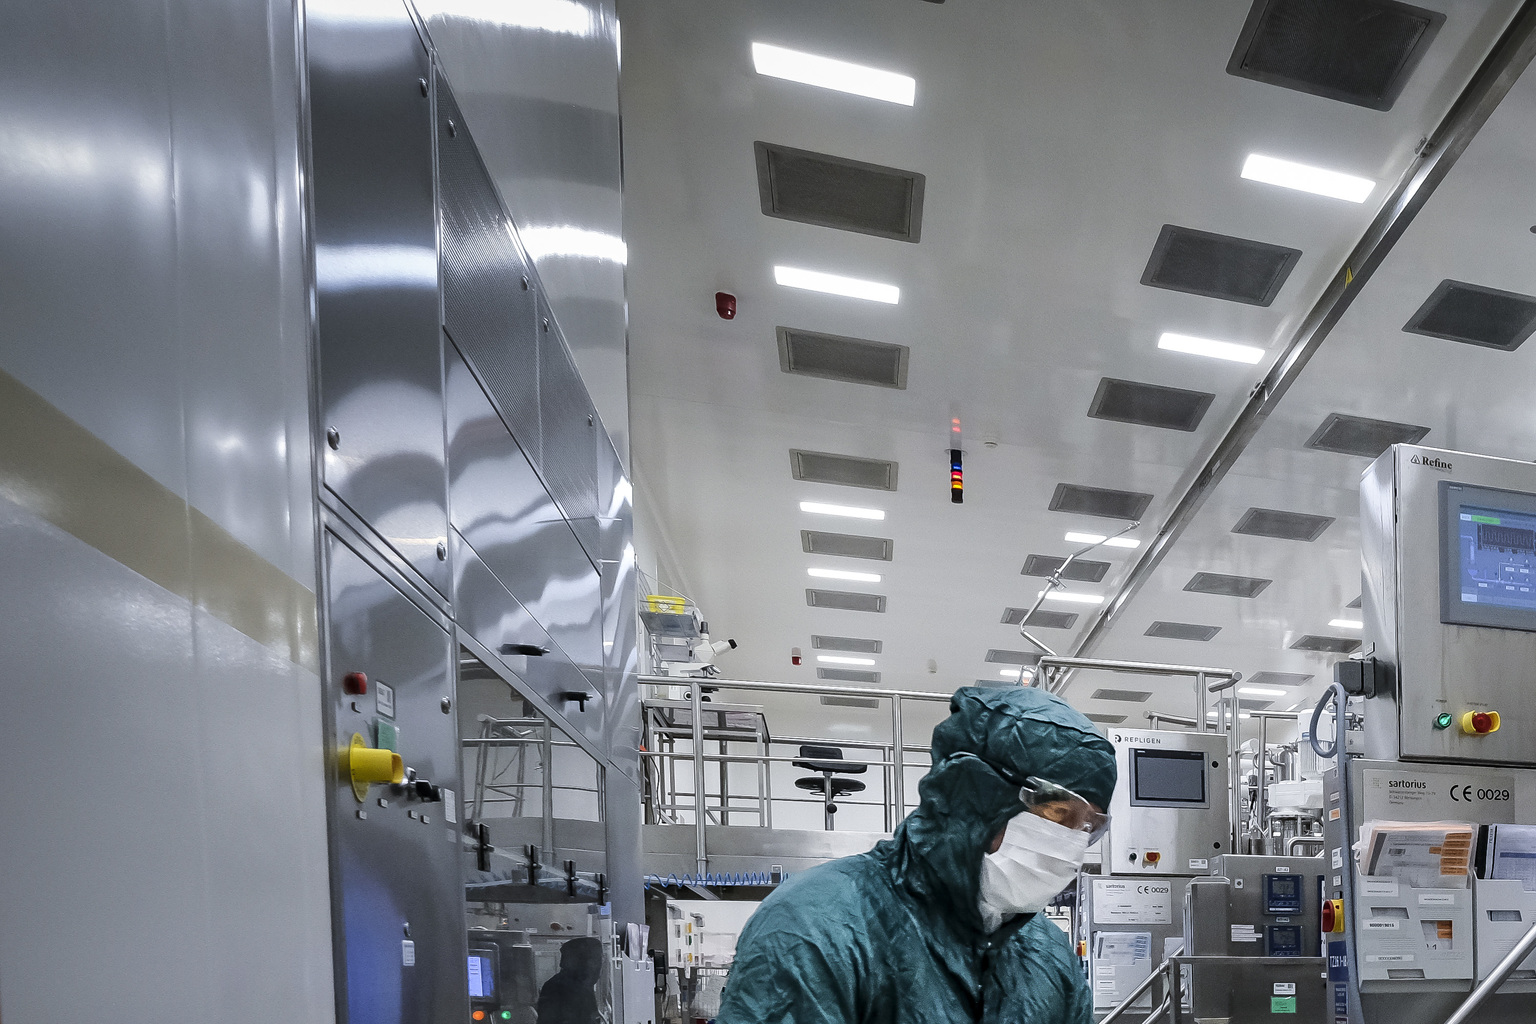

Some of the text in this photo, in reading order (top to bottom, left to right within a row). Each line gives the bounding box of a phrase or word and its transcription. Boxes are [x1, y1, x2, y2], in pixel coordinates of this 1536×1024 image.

[1422, 456, 1453, 469] Refine
[1124, 736, 1161, 744] REPLIGEN
[1388, 779, 1427, 789] sartorius
[1477, 788, 1510, 801] 0029
[1151, 886, 1169, 894] 0029
